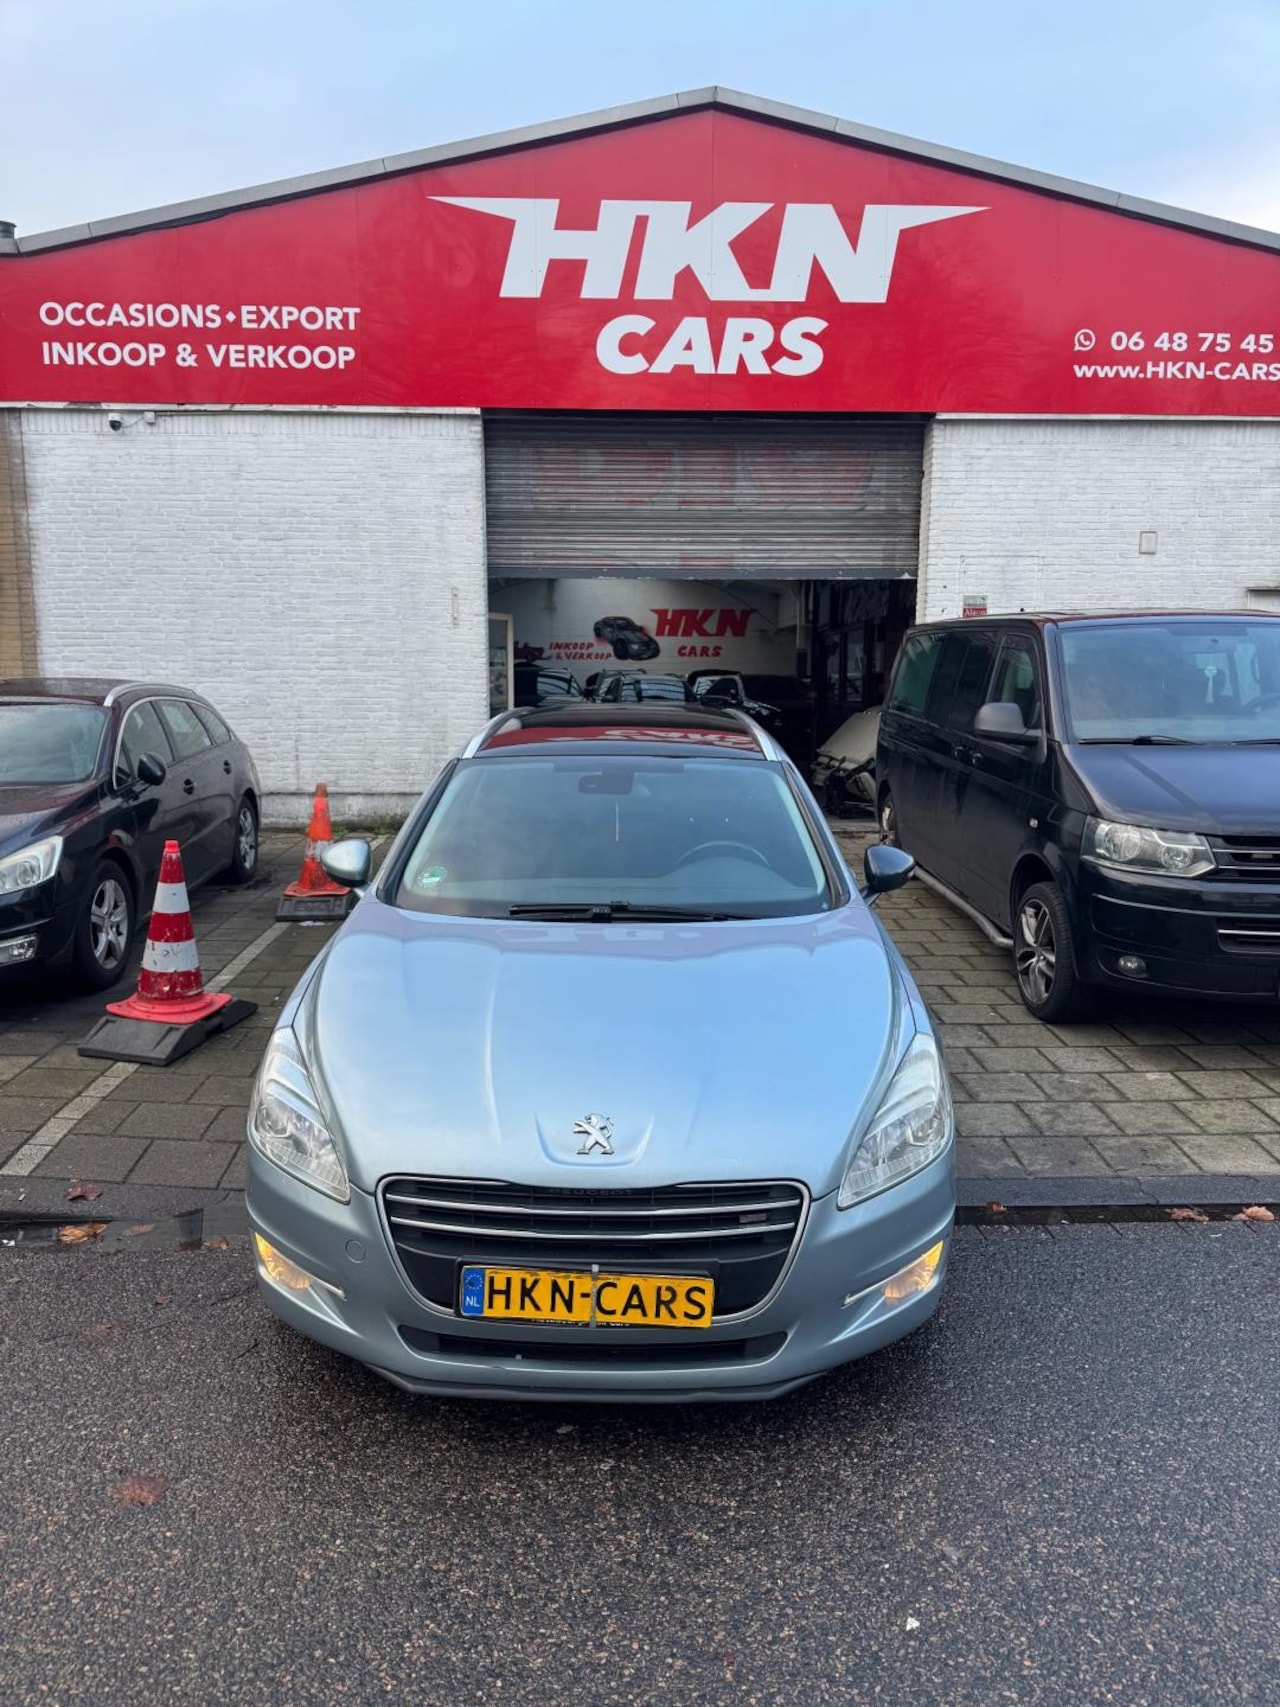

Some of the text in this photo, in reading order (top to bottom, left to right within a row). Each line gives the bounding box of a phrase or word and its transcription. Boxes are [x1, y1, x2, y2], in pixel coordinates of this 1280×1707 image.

[426, 196, 992, 303] HKN
[42, 341, 356, 369] INKOOP & VERKOOP
[596, 314, 830, 376] CARS
[1110, 331, 1274, 353] 06 48 75 45
[650, 609, 759, 637] HKN
[549, 642, 594, 650] INKOOP
[677, 645, 722, 657] CARS
[466, 1296, 480, 1308] NL
[487, 1276, 706, 1320] HKN-CARS
